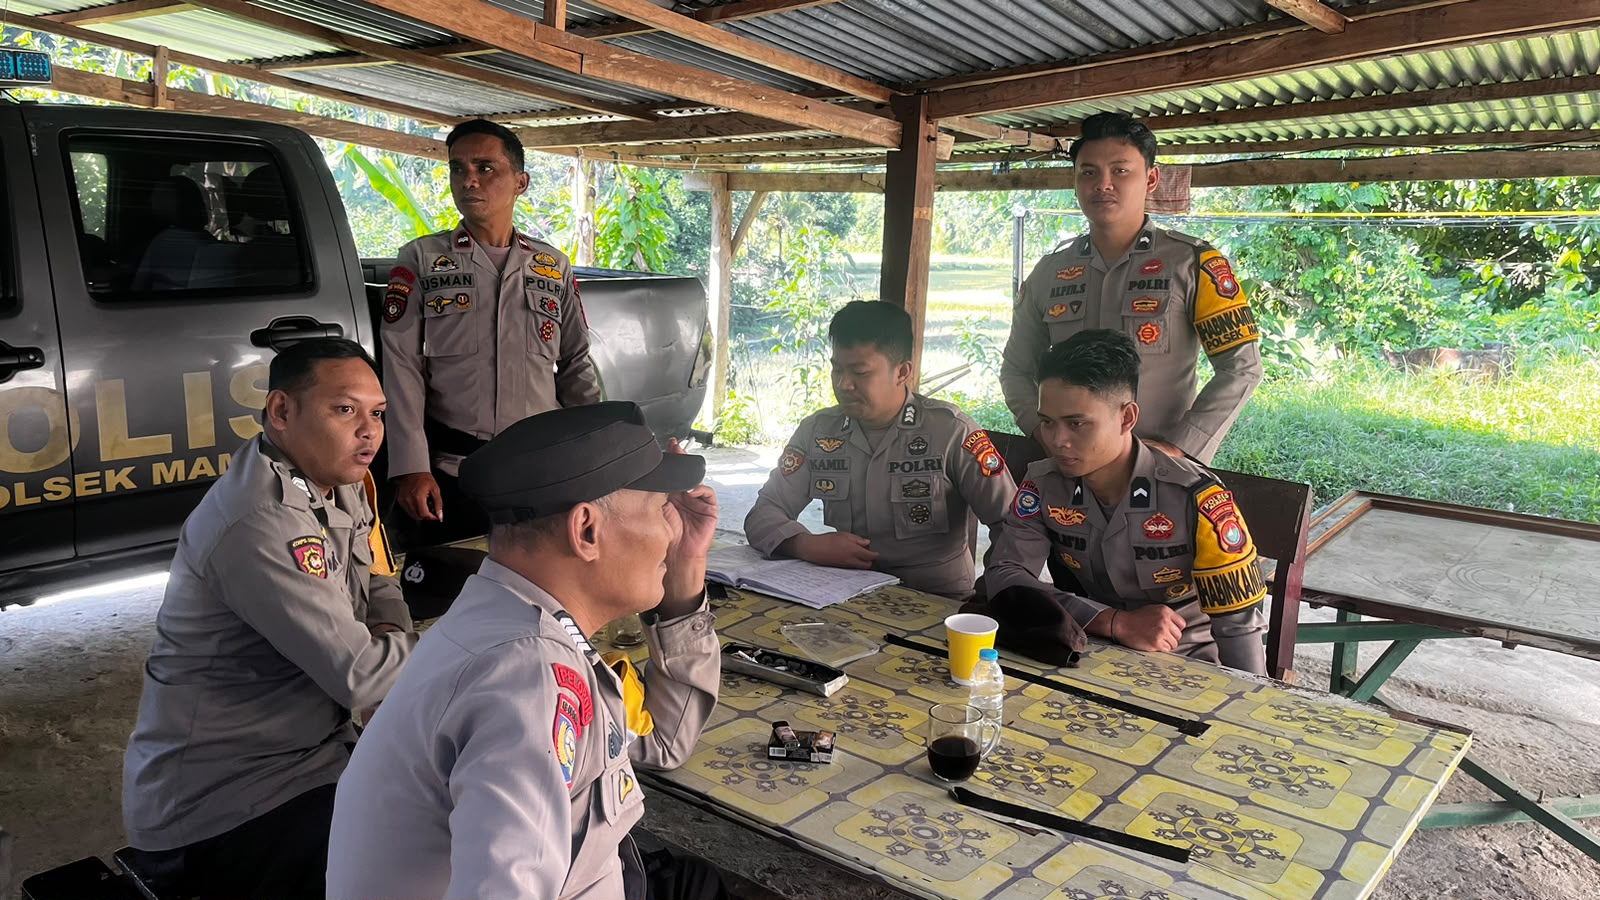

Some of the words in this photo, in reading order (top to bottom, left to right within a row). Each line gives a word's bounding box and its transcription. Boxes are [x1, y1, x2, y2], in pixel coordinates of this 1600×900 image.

[421, 275, 472, 290] USMAN
[1128, 279, 1170, 291] POLRI
[1206, 328, 1243, 350] POLSEK
[809, 459, 848, 471] KAMIL
[888, 456, 943, 473] POLRI
[1133, 544, 1188, 560] POLRI
